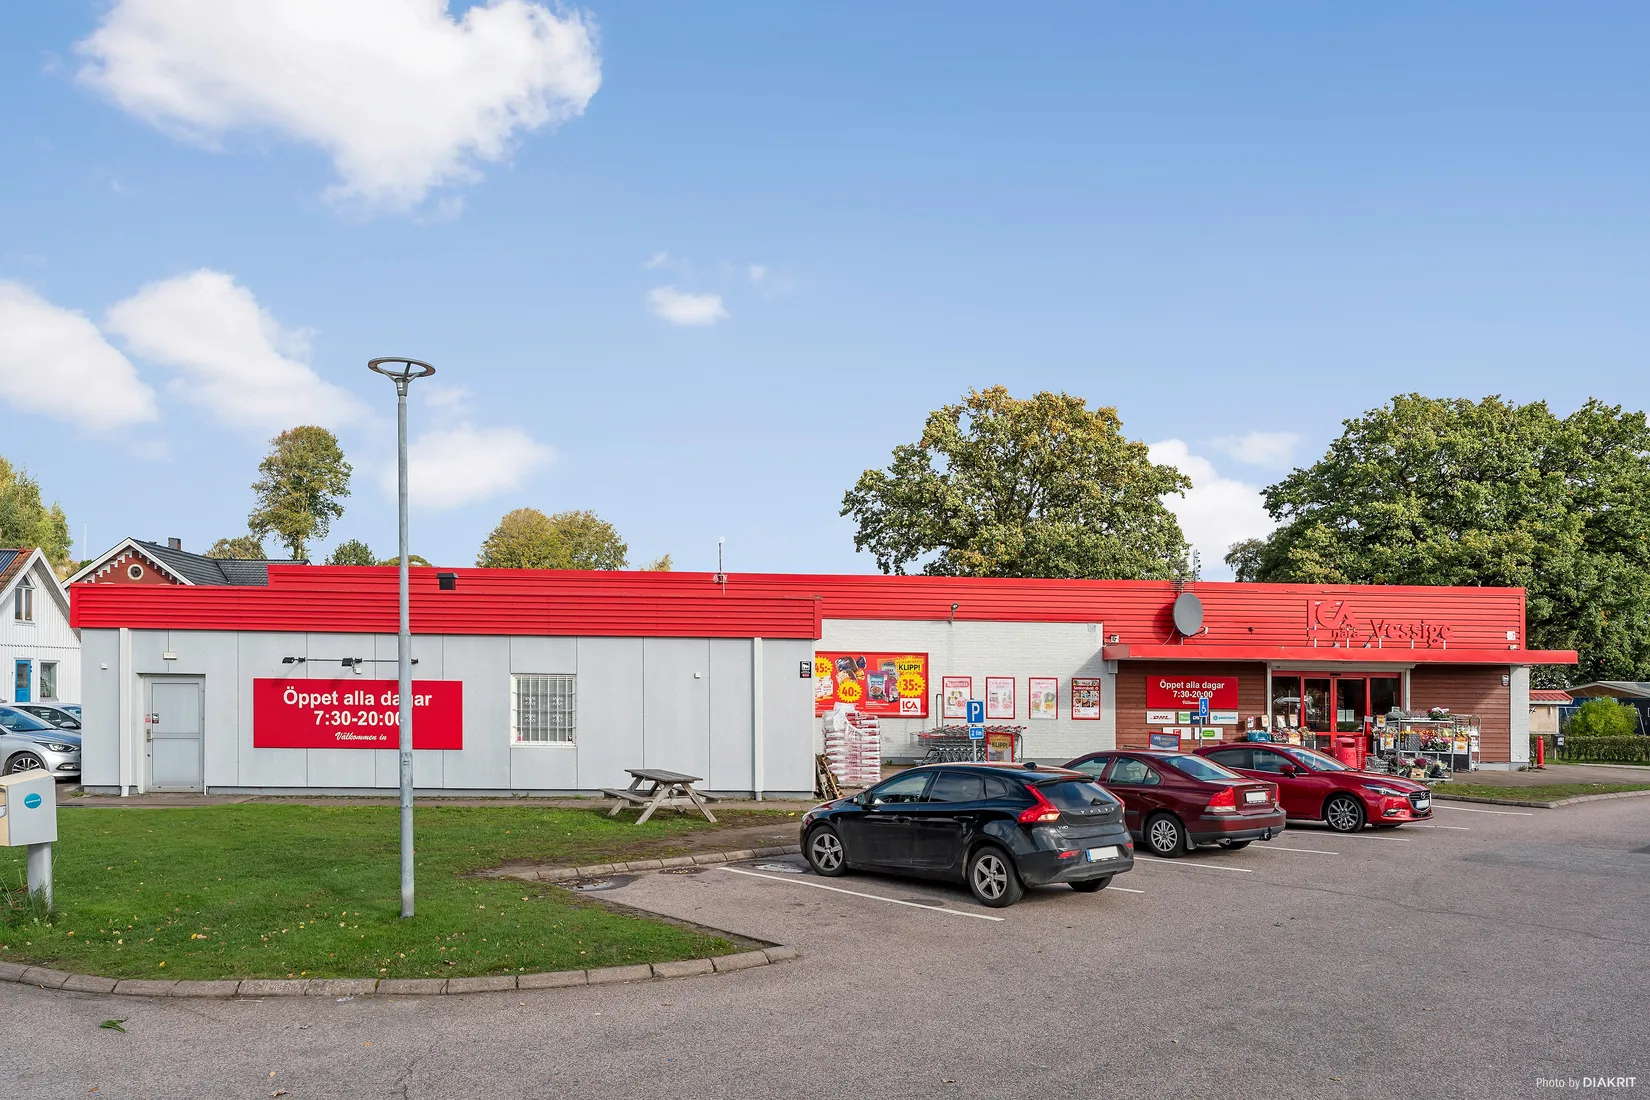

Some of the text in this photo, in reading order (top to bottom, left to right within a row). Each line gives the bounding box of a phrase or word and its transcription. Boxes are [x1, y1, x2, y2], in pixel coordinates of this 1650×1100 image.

[902, 679, 922, 691] 35:-
[1159, 679, 1225, 691] Öppet alla dagar
[841, 686, 860, 697] 40:-
[1172, 690, 1214, 699] 7:30-20:00
[283, 686, 433, 709] Öppet alla daar
[902, 700, 918, 709] ICA
[971, 702, 980, 721] P
[335, 731, 387, 741] Välkommen in
